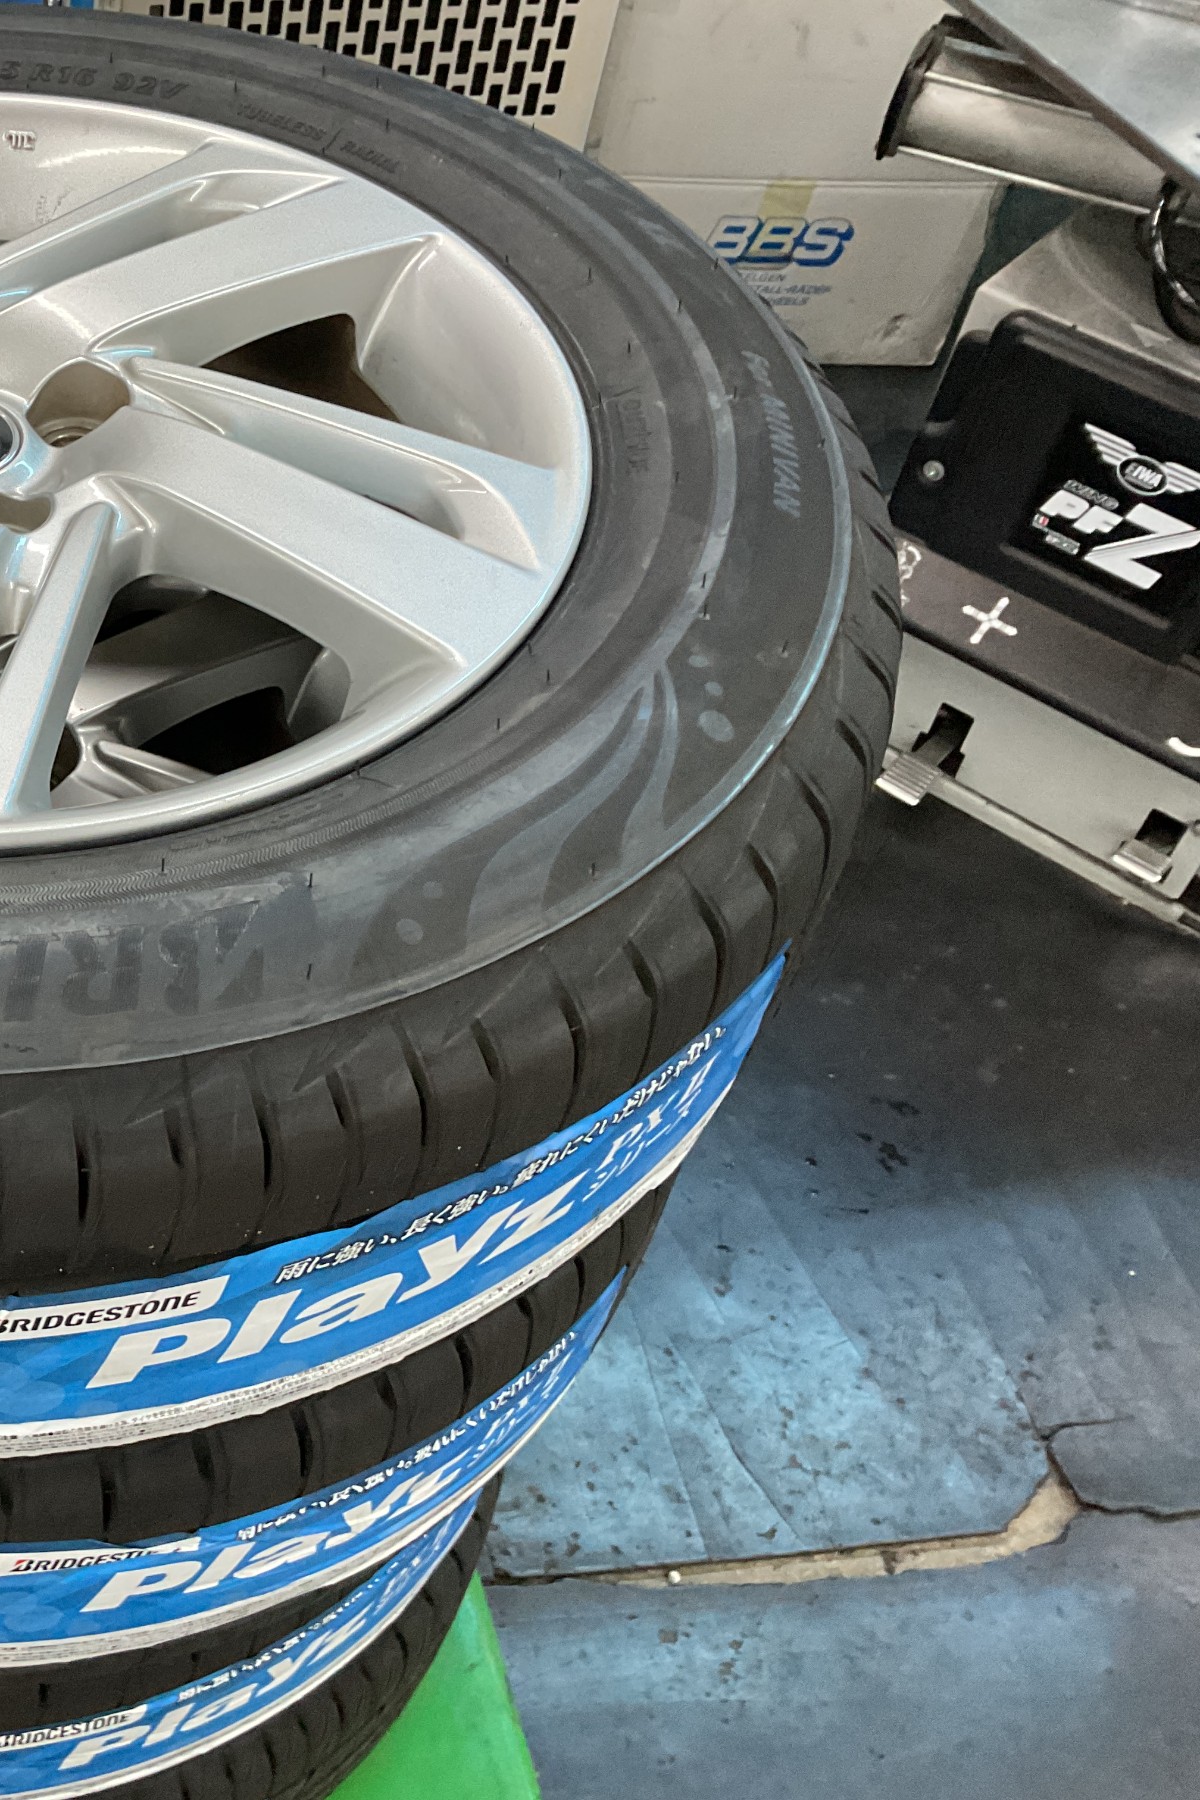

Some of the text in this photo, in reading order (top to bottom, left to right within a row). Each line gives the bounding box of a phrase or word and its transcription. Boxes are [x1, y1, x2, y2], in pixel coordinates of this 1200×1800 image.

[706, 214, 855, 269] BBS
[759, 392, 801, 519] MINIVAN
[85, 1168, 591, 1390] Playz
[79, 1446, 472, 1613] Playz
[57, 1601, 376, 1771] Playz
